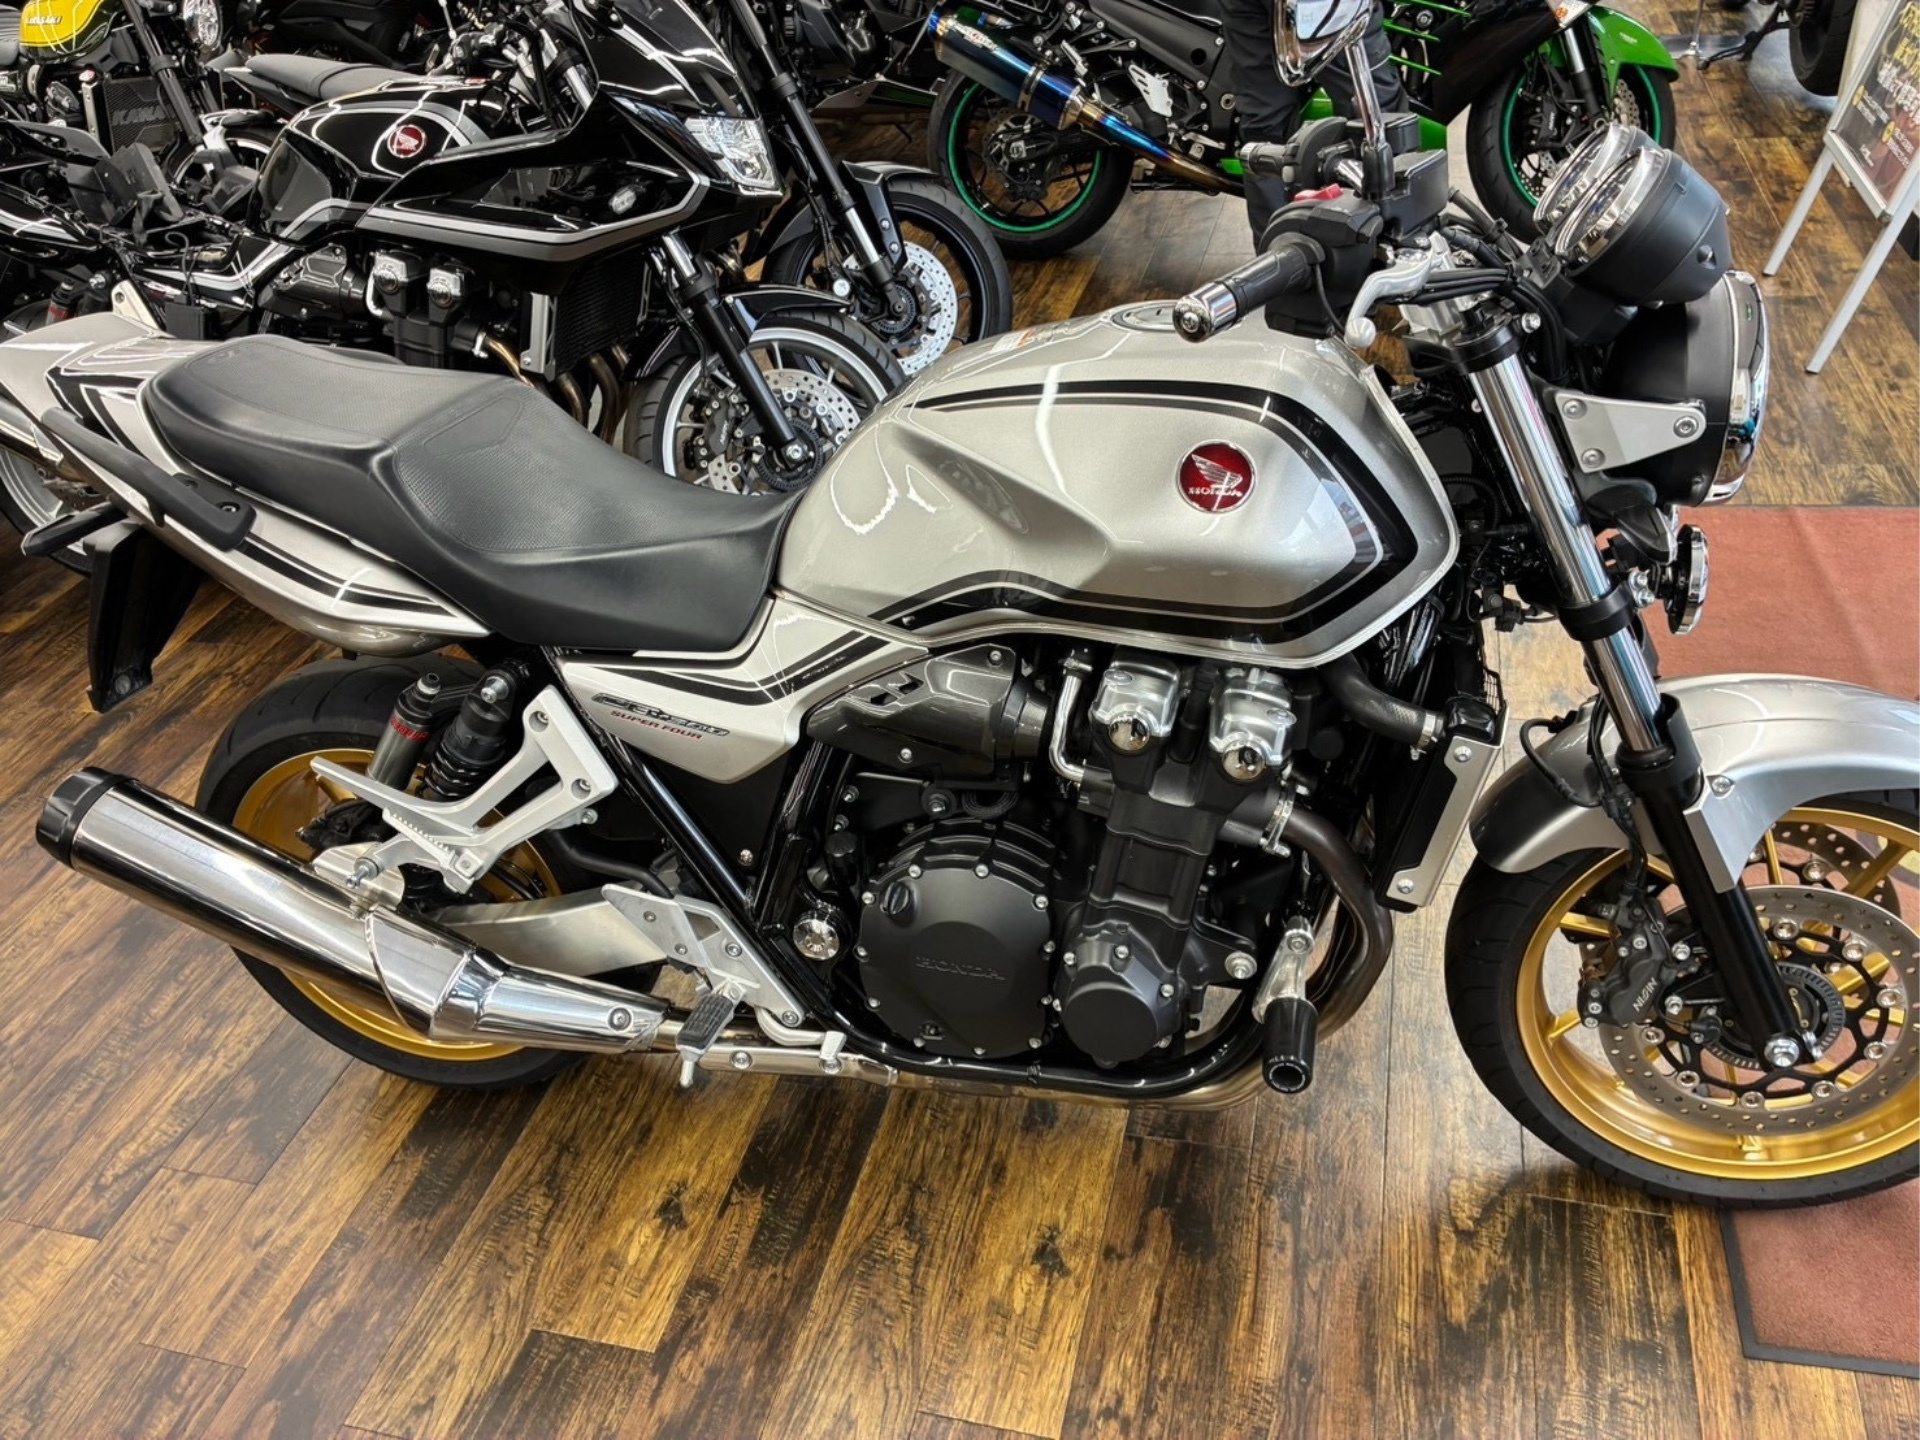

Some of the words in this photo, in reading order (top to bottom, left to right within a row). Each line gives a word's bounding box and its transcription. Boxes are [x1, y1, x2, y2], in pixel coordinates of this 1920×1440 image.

[610, 710, 660, 729] SUPER
[661, 725, 702, 740] FOUR
[915, 955, 1006, 981] HONDA
